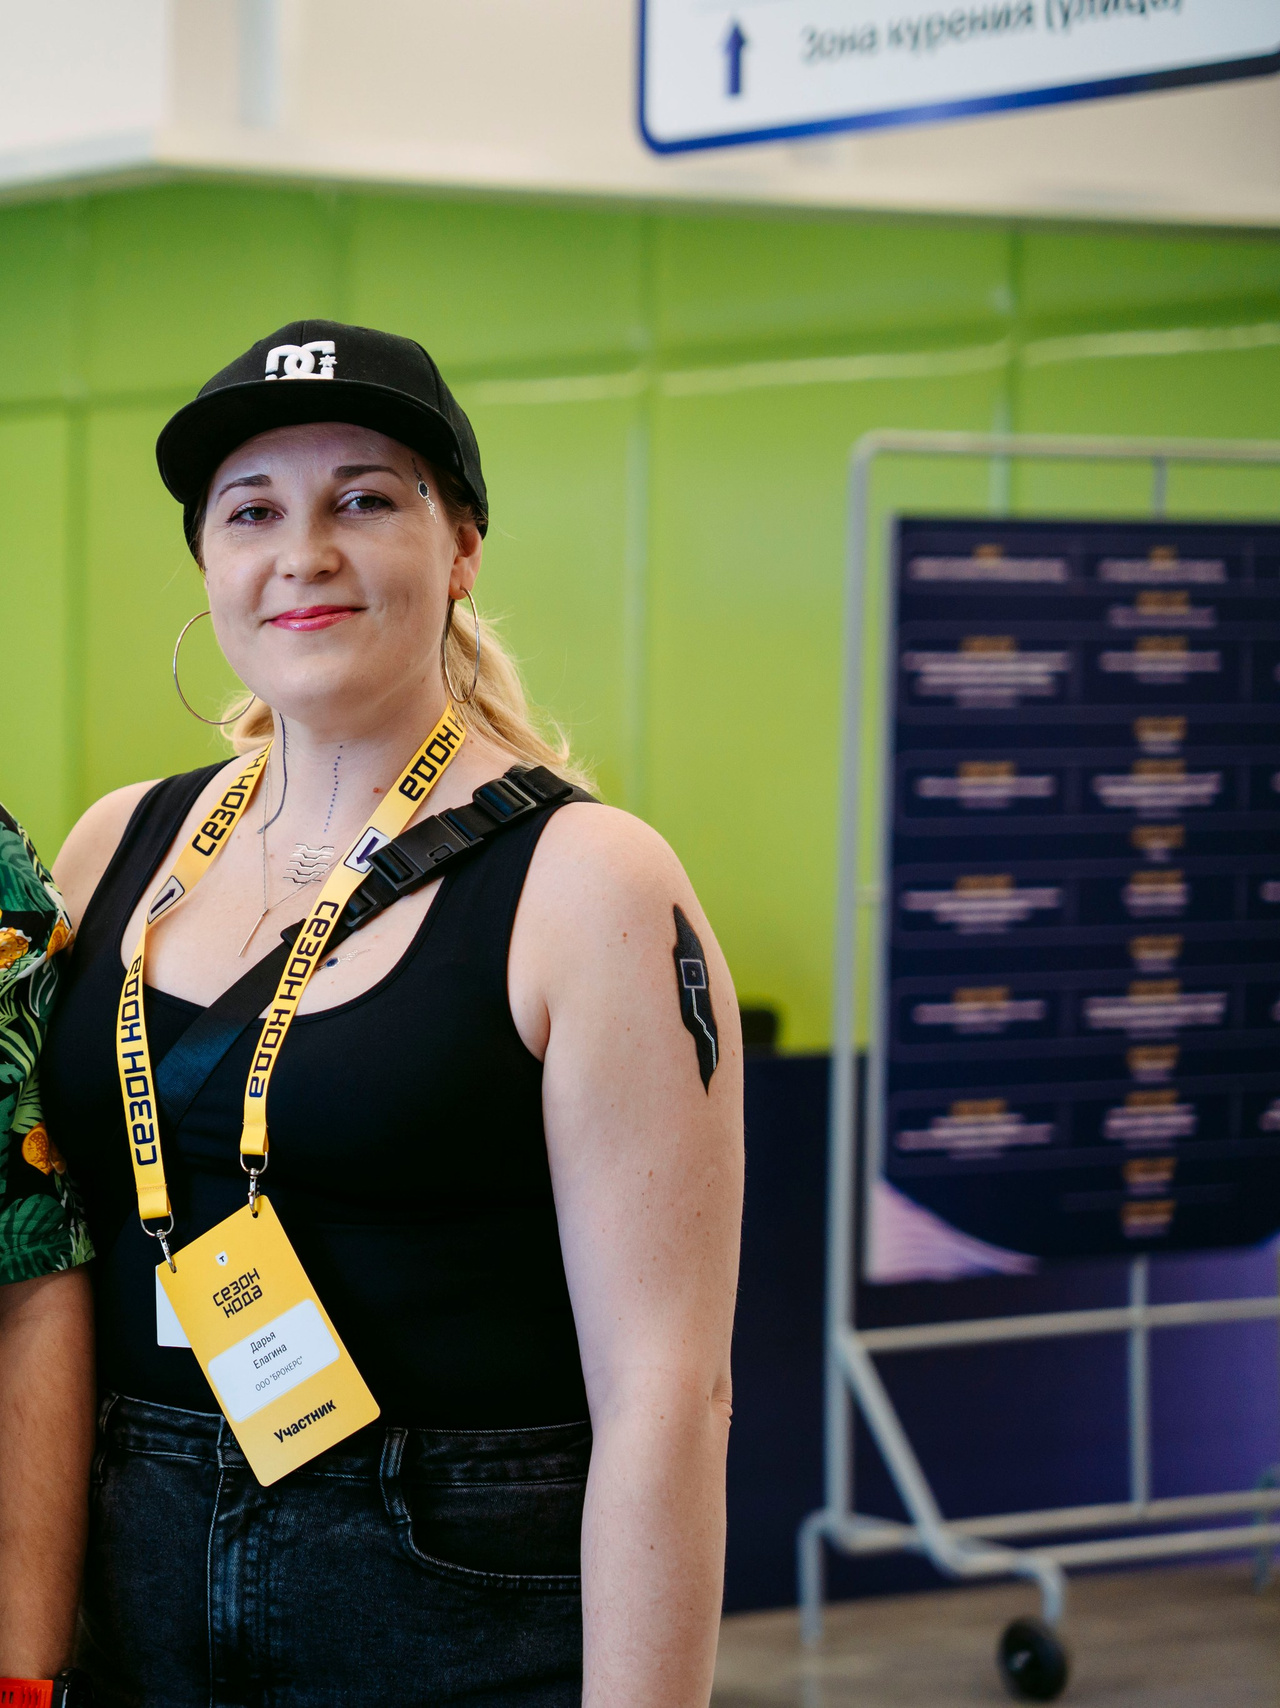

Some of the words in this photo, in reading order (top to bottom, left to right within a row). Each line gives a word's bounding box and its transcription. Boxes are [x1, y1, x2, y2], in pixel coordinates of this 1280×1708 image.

[801, 22, 878, 63] Зона
[885, 1, 1034, 51] курения
[213, 1267, 261, 1307] сезон
[223, 1284, 263, 1318] кода
[250, 1331, 277, 1354] Дарья
[253, 1343, 287, 1369] Елагина
[255, 1375, 271, 1392] ООО
[273, 1399, 337, 1443] Участник
